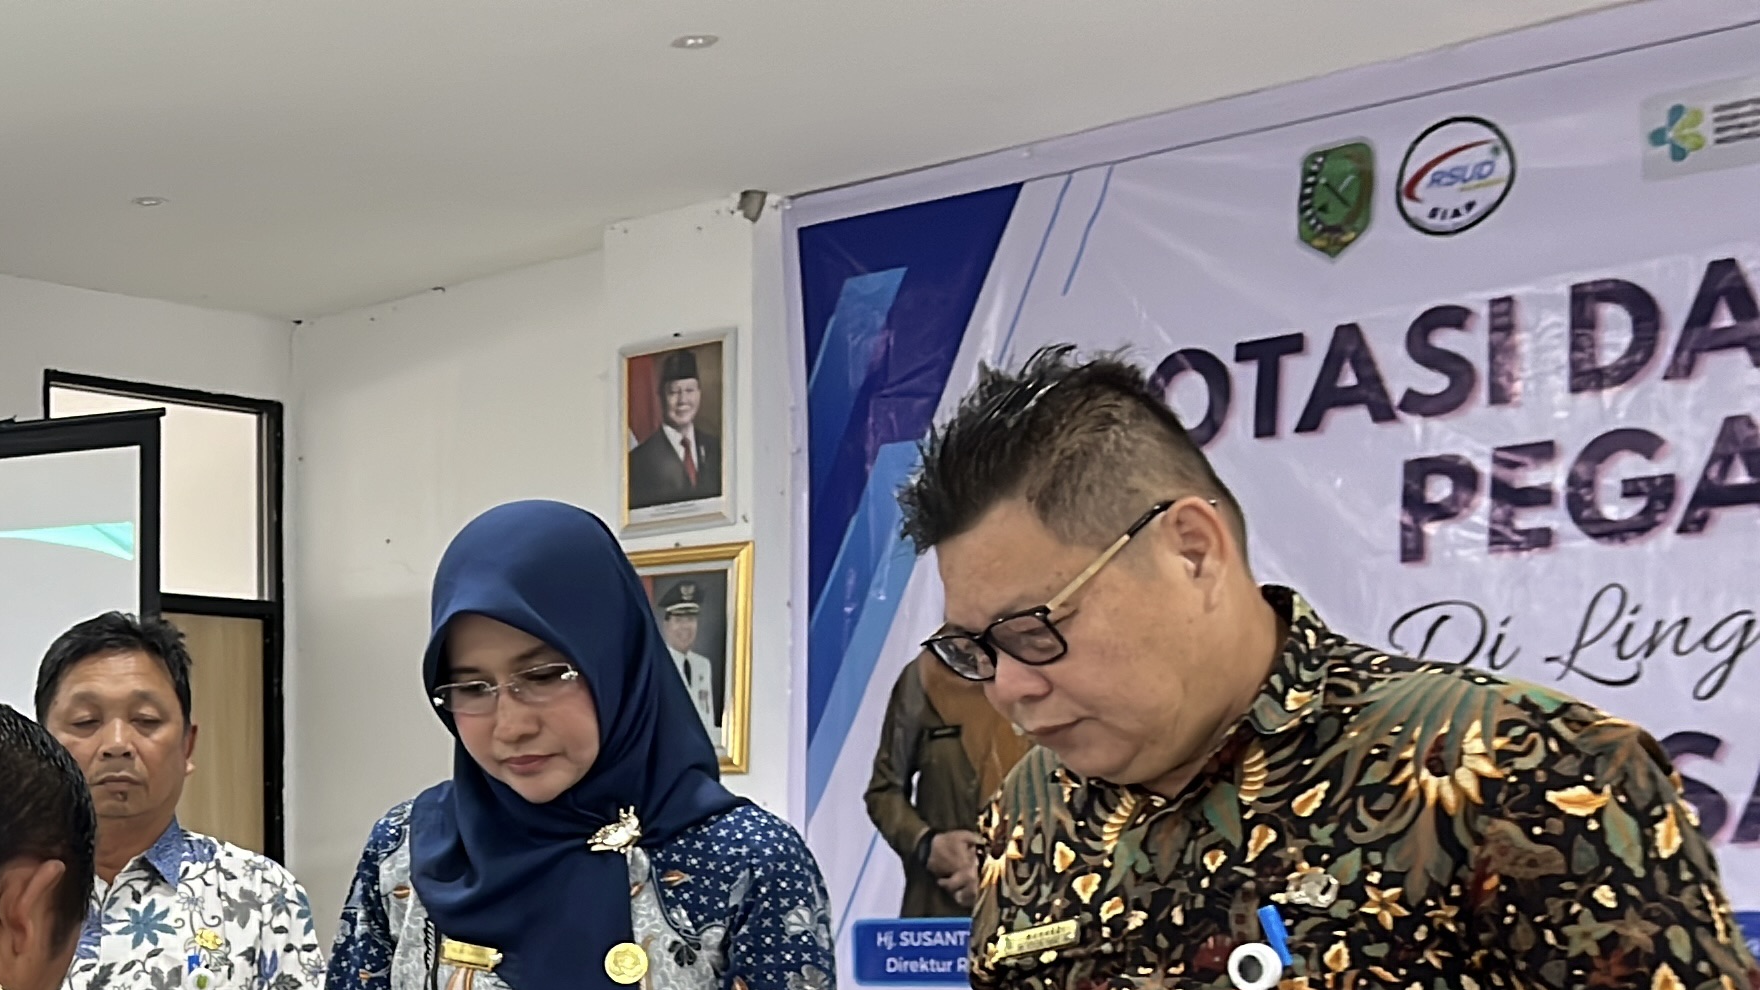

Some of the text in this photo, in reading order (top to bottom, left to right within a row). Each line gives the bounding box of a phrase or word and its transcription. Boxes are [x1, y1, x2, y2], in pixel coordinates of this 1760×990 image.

[1426, 160, 1496, 188] RSUD
[1146, 295, 1516, 447] OTASI
[1389, 582, 1760, 701] Di Ling
[886, 957, 953, 973] Direktur
